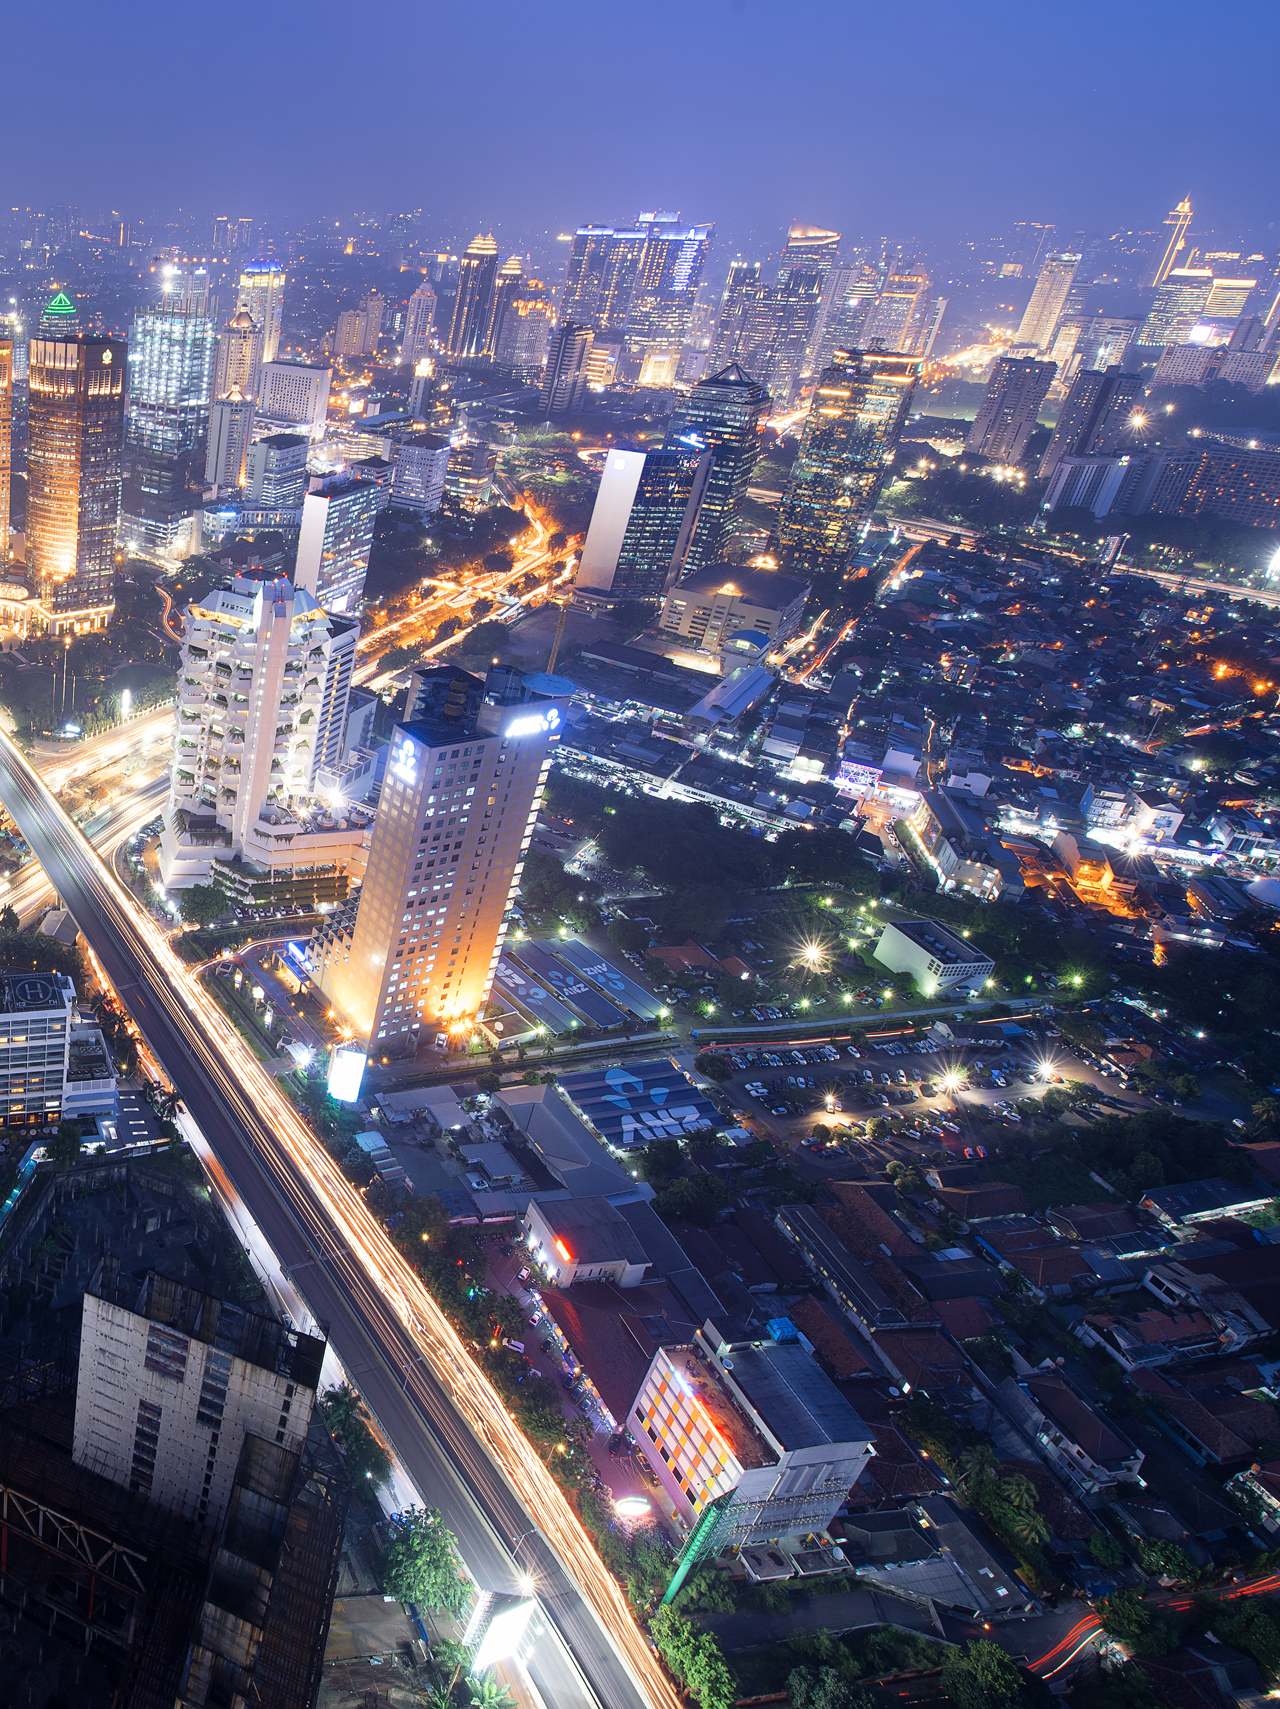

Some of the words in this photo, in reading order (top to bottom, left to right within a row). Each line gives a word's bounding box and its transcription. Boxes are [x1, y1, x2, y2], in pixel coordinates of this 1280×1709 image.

[495, 962, 526, 988] NZ
[582, 963, 608, 975] ANZ
[24, 982, 43, 1000] H
[563, 983, 590, 996] ANZ
[621, 1105, 714, 1144] ANZ
